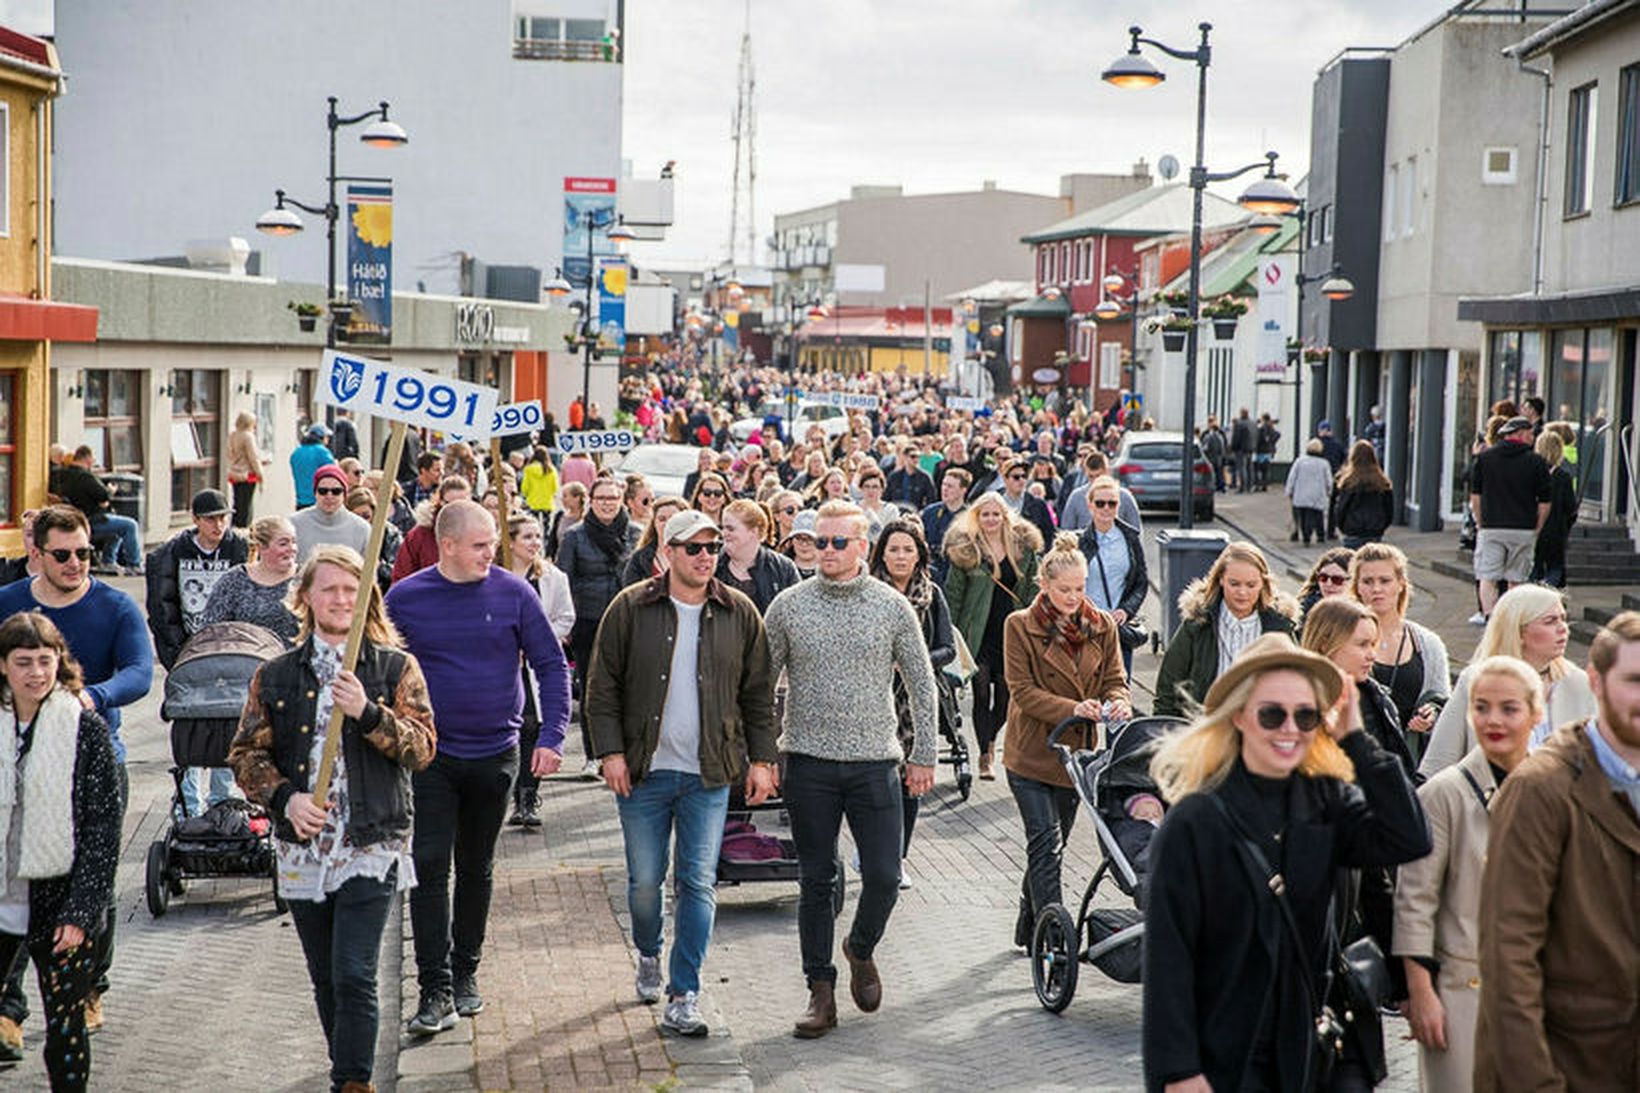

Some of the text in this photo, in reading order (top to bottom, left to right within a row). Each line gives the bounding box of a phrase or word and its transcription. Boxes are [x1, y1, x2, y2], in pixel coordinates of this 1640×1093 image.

[373, 371, 479, 427] 1991
[492, 404, 540, 432] 990
[578, 432, 631, 448] 1989
